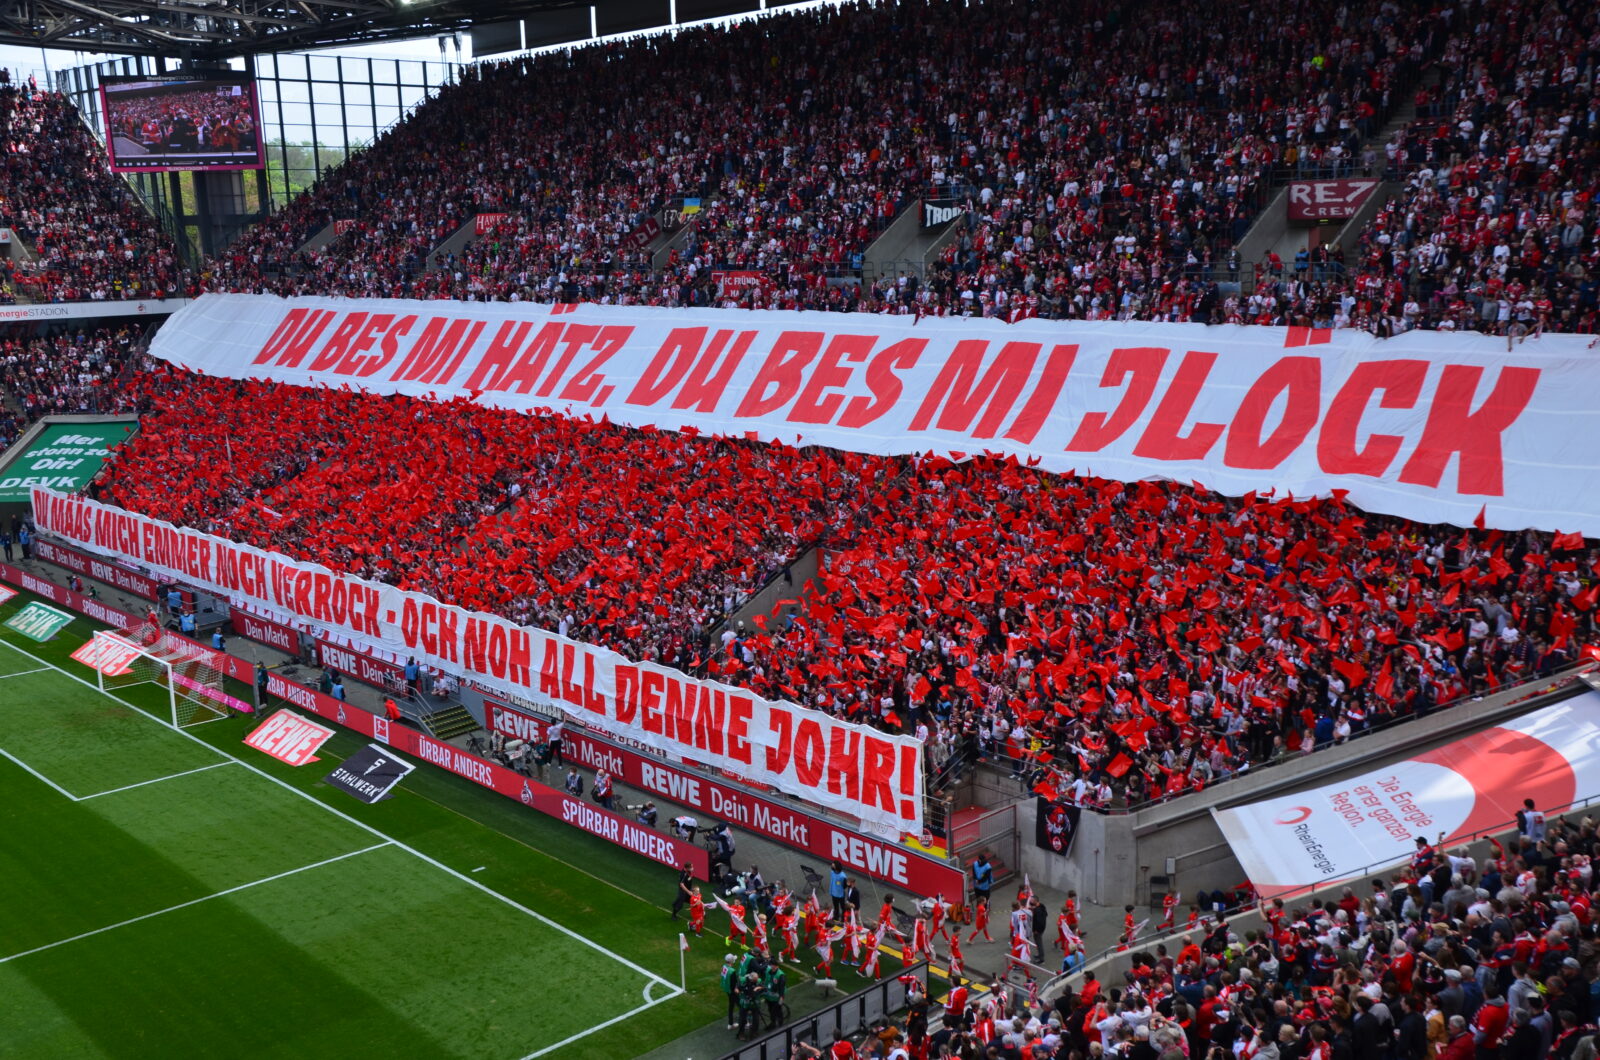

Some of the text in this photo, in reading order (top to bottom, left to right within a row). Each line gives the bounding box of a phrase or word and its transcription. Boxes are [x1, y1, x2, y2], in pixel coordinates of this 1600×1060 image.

[1303, 206, 1355, 217] CREW
[252, 308, 336, 368] DU
[308, 312, 419, 377] BES
[390, 316, 487, 385] MI
[463, 303, 636, 408] HÄTZ,
[625, 327, 759, 413] DU
[734, 332, 930, 429] BES
[908, 340, 1080, 445] MI
[51, 435, 104, 446] Mer
[0, 476, 80, 488] DEVK
[30, 457, 84, 470] Dir!
[91, 561, 115, 583] REWE
[115, 569, 130, 588] Dein
[8, 605, 63, 638] DEVK
[51, 494, 92, 543] MÄÄS
[95, 508, 141, 559] MICH
[143, 522, 212, 582] EMMER
[216, 543, 268, 601] NOCH
[271, 560, 381, 639] VERRÖCK
[401, 597, 458, 664] OCH
[464, 617, 531, 689] NOH
[540, 638, 606, 716] ALL
[614, 664, 752, 765] DENNE
[244, 618, 290, 649] Dein Markt
[321, 644, 358, 675] REWE
[361, 659, 384, 685] Dein
[287, 683, 319, 712] ANDERS.
[249, 714, 324, 762] REWE
[493, 708, 624, 777] REWE ein Markt
[454, 747, 496, 788] ANDERS.
[641, 761, 702, 806] REWE
[710, 787, 748, 824] Dein
[754, 803, 809, 847] Markt
[1329, 791, 1365, 828] Region.
[1353, 785, 1412, 842] einer ganzen
[1390, 791, 1433, 827] Energie
[562, 799, 679, 867] SPÜRBAR ANDERS.
[1294, 823, 1337, 875] RheinEnergie
[831, 830, 909, 885] REWE
